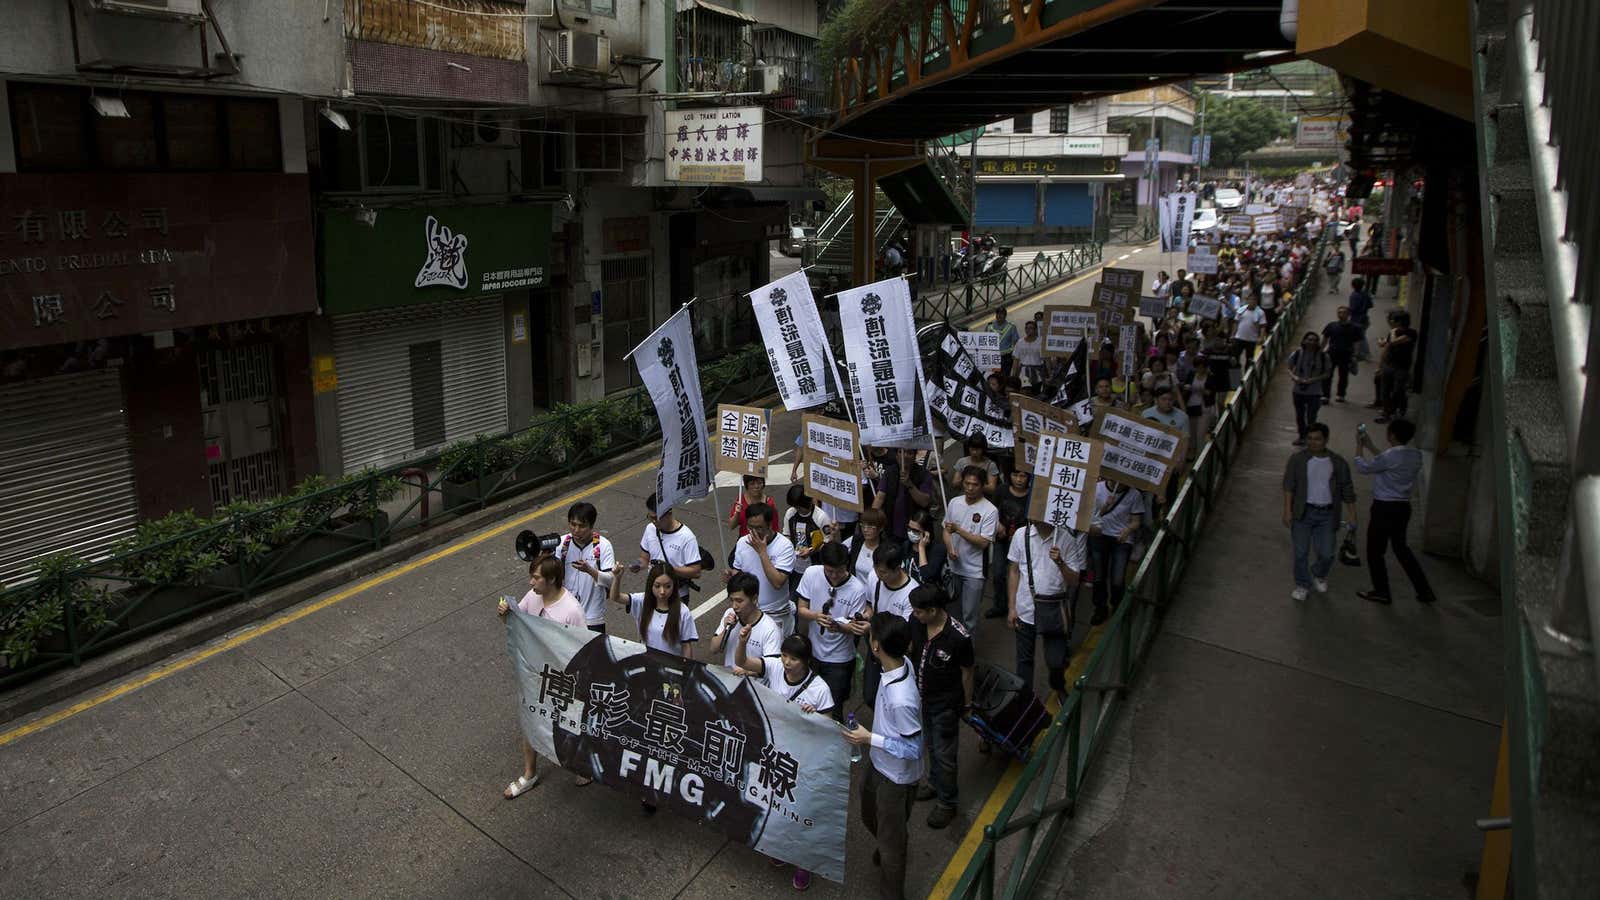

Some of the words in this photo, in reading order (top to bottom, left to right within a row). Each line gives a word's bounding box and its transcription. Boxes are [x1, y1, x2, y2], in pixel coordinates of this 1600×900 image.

[677, 123, 750, 143] 羅氏翻譯
[13, 207, 169, 242] 有限公司
[1104, 419, 1174, 453] 賭場毛利高
[539, 664, 799, 802] 博彩最前線
[620, 735, 640, 749] OF
[648, 745, 680, 765] THE
[619, 748, 705, 806] FMG
